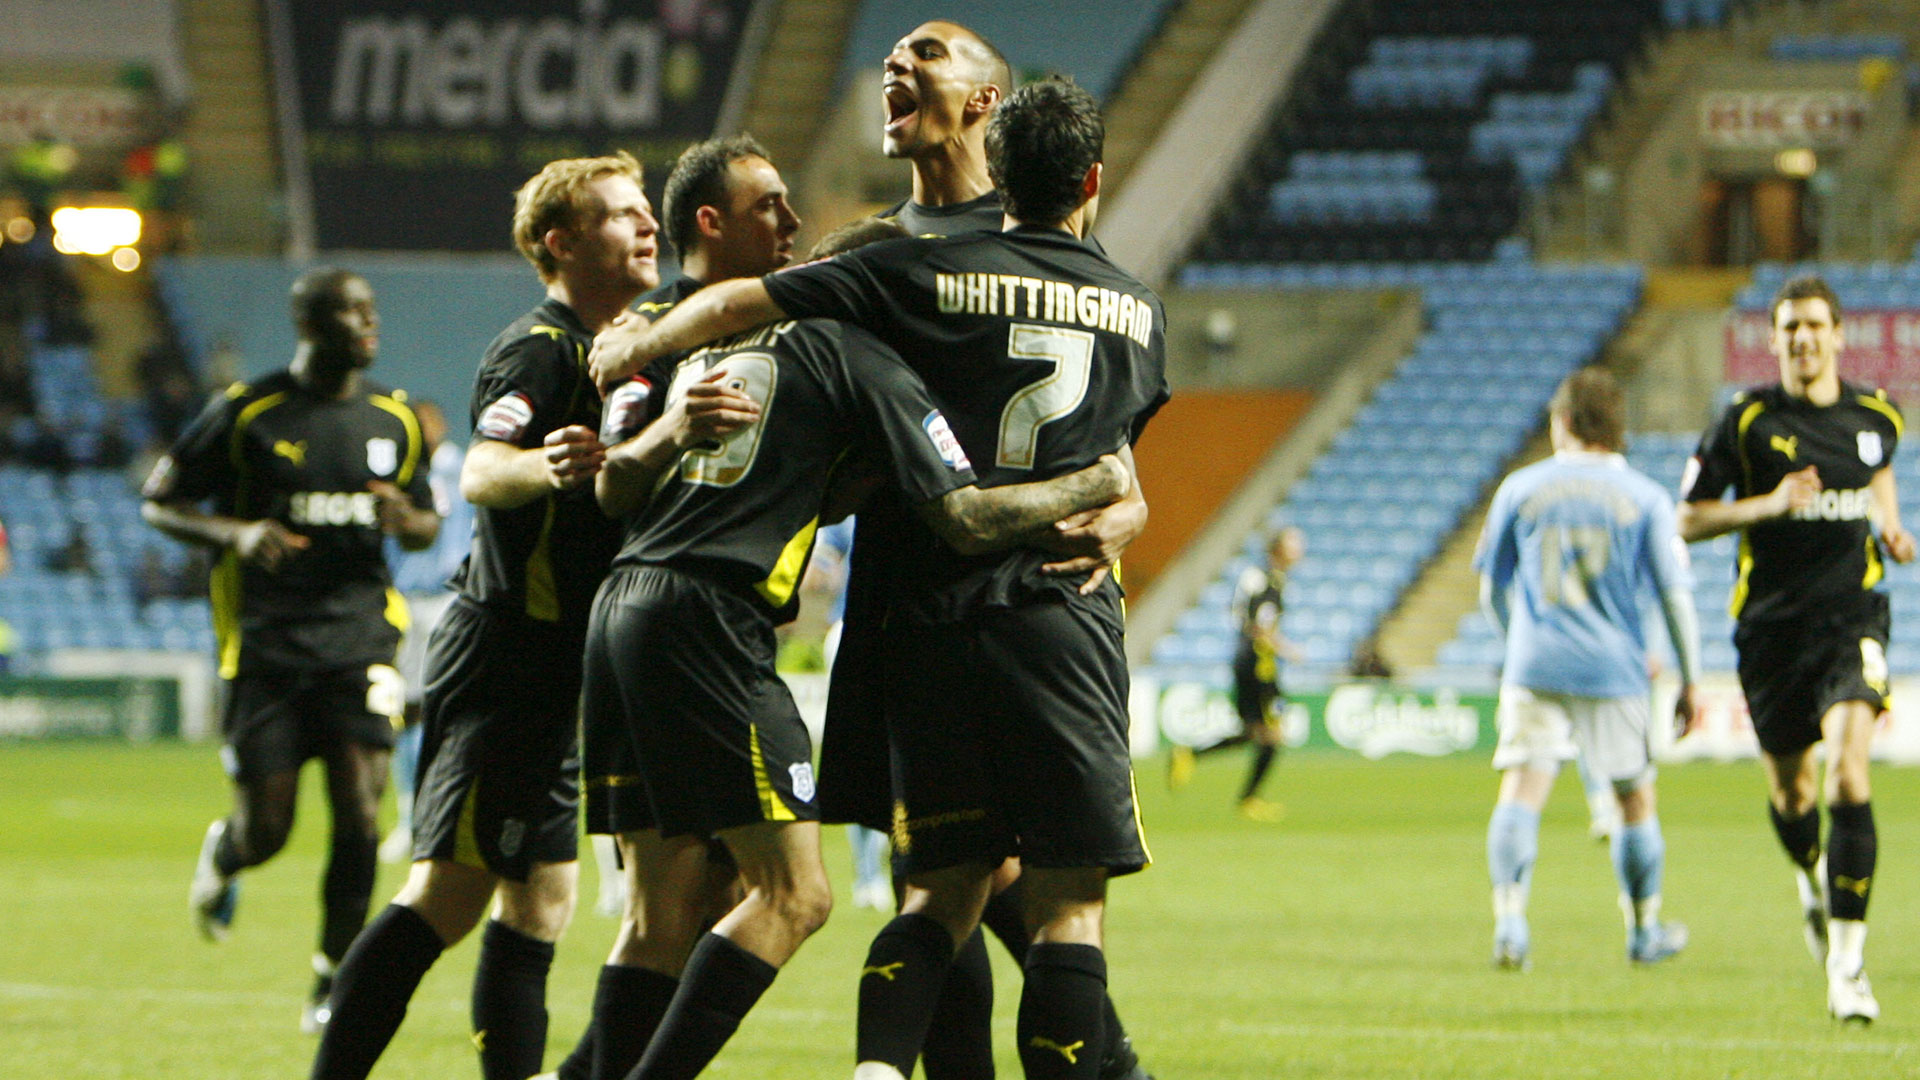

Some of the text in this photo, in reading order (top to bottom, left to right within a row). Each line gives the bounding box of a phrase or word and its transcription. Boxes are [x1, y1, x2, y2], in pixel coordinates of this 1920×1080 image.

[331, 0, 660, 124] mercia
[936, 272, 1152, 350] WHITTINGHAM
[996, 322, 1096, 471] 7
